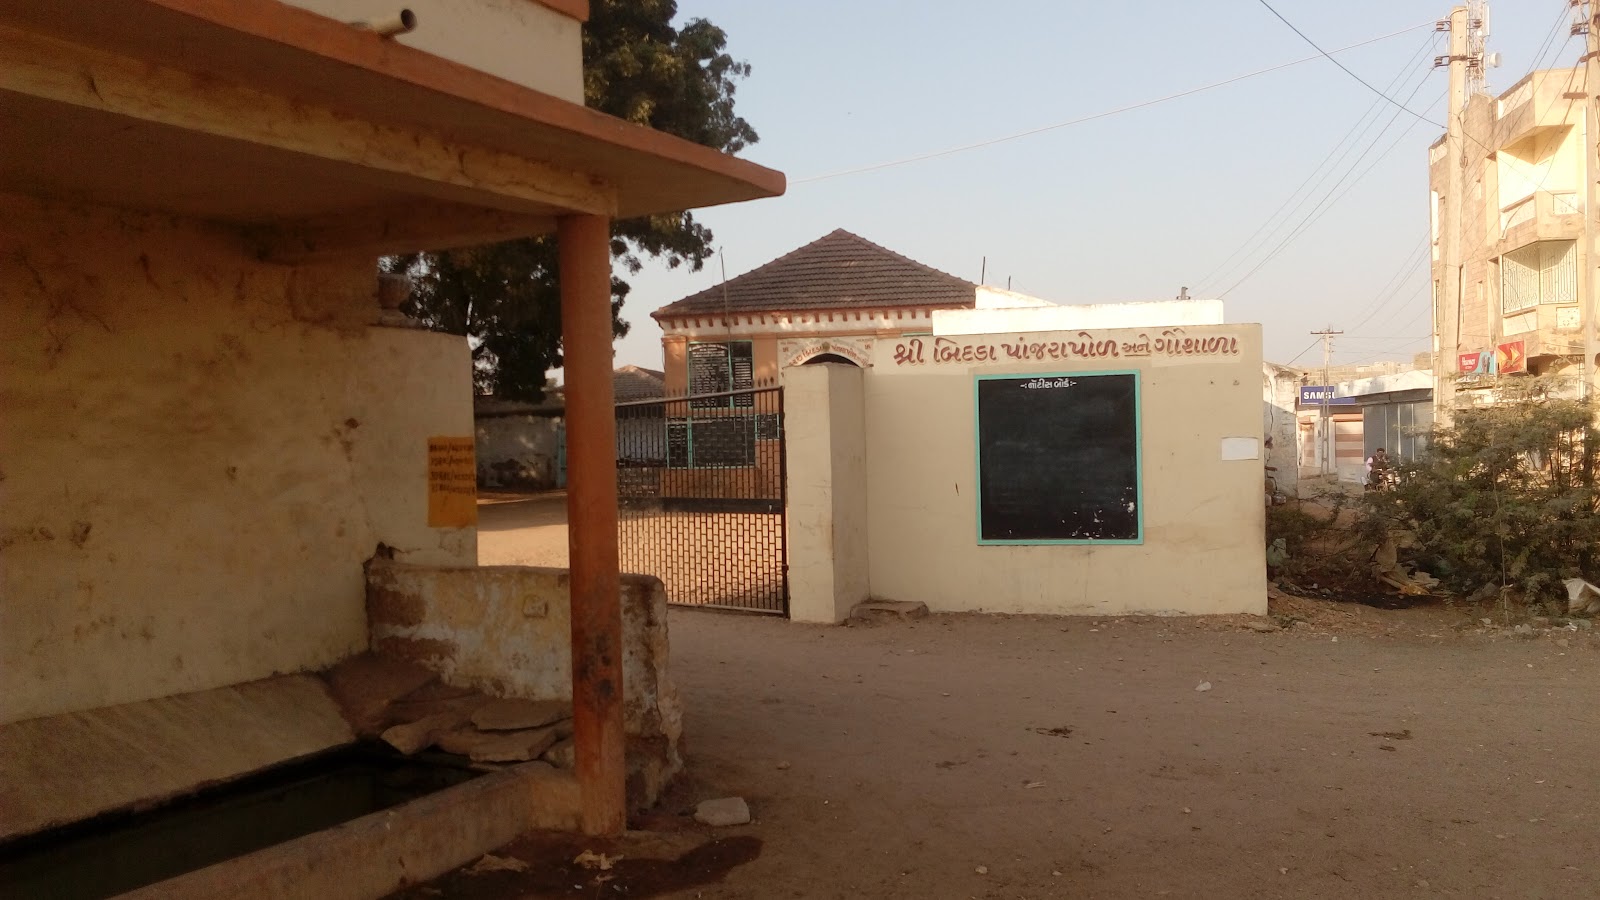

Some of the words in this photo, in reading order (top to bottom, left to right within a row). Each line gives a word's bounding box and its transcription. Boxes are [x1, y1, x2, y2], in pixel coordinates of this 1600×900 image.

[893, 338, 925, 366] શ્રી
[933, 337, 997, 363] બિદડા
[1001, 332, 1120, 360] પાંજરાપોળ
[1121, 333, 1151, 354] અને
